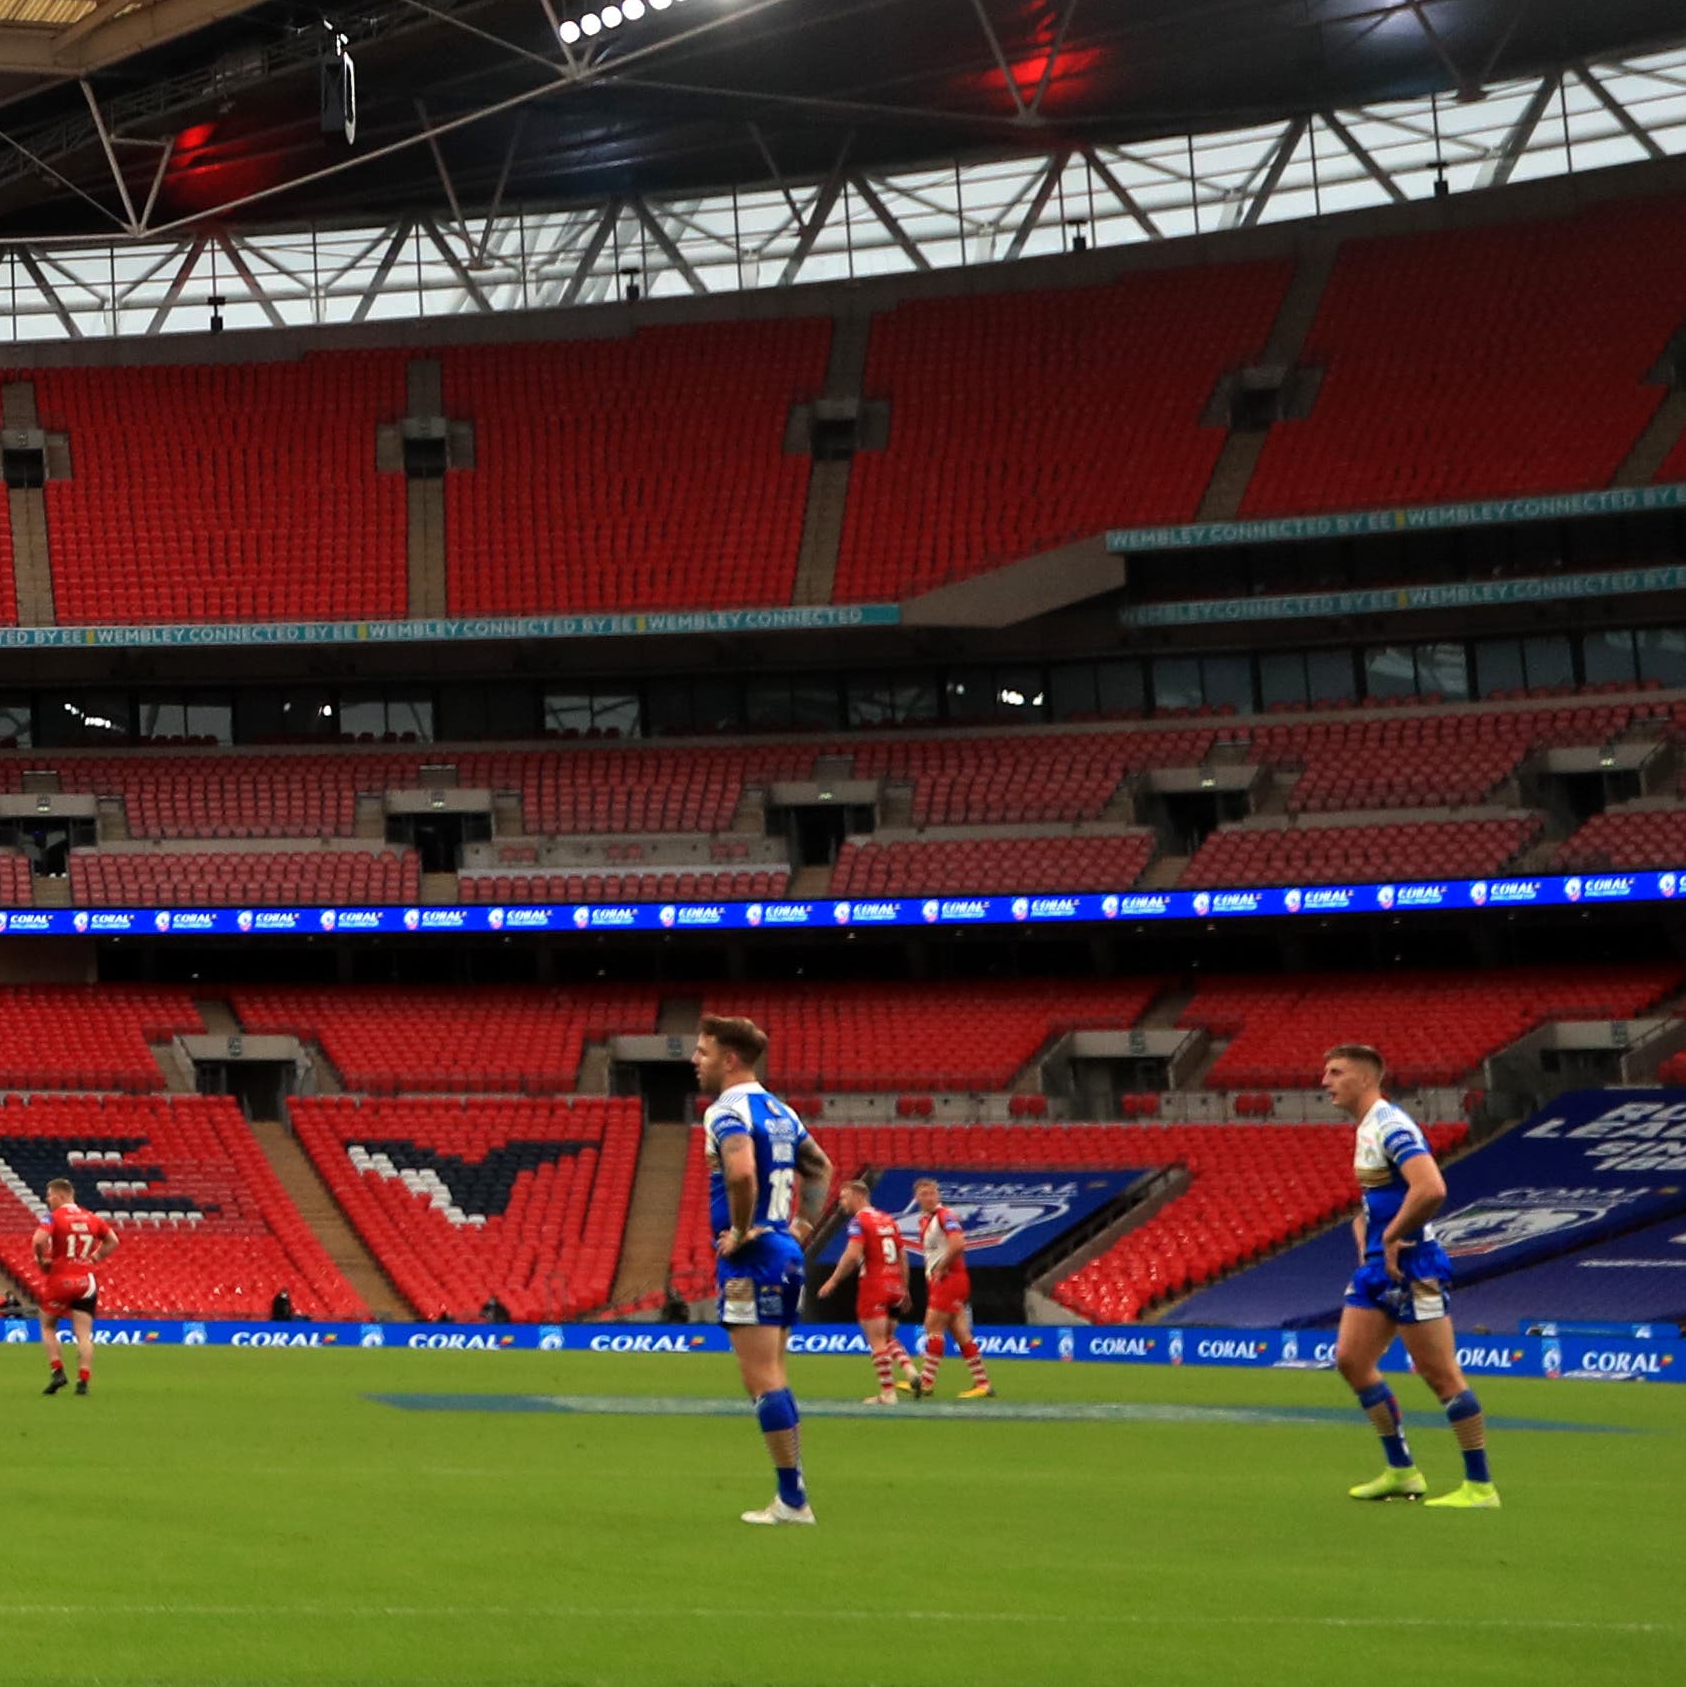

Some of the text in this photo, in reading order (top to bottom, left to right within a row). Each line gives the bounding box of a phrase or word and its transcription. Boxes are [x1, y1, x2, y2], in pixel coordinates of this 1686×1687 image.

[34, 629, 57, 644] BY
[61, 629, 81, 644] EE
[768, 1168, 795, 1221] 16
[66, 1234, 94, 1259] 17
[881, 1237, 898, 1264] 9
[231, 1331, 324, 1348] CORAL
[408, 1332, 501, 1350] CORAL
[590, 1334, 689, 1353] CORAL
[786, 1334, 870, 1354] CORA
[1089, 1337, 1148, 1356] CORAL
[1197, 1338, 1258, 1359] CORAL
[1456, 1346, 1513, 1368] ORAL
[1581, 1351, 1661, 1373] CORAL
